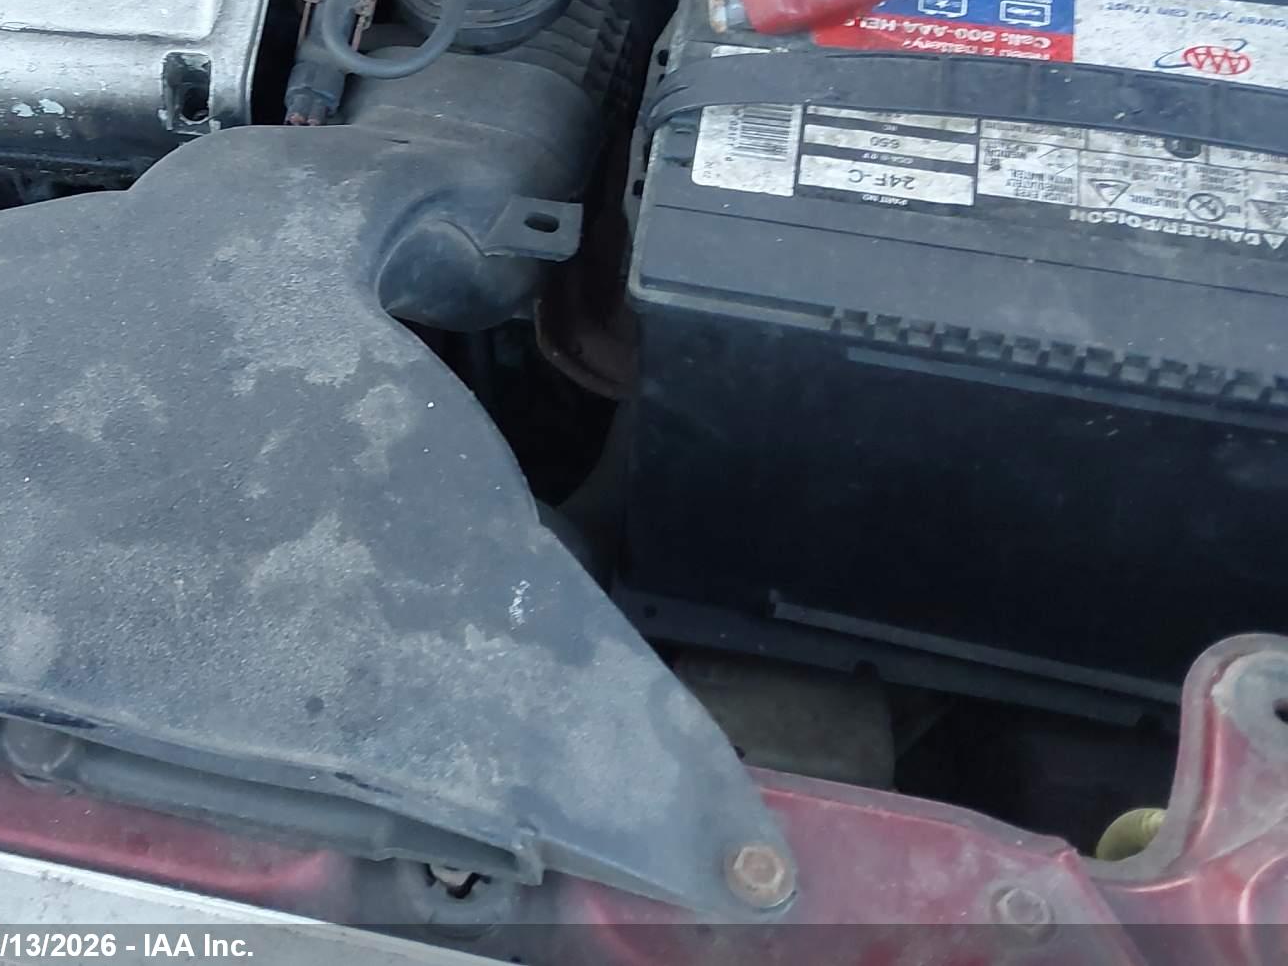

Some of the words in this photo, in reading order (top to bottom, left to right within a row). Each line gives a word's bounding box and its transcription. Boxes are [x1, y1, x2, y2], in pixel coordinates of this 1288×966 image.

[1157, 7, 1189, 18] can
[1192, 11, 1233, 24] you
[1238, 16, 1288, 30] ower
[999, 32, 1052, 49] Call:
[1190, 46, 1242, 75] AAA
[870, 136, 900, 149] 650
[847, 169, 916, 191] 24F-C
[1069, 208, 1261, 246] DANGER/POISON
